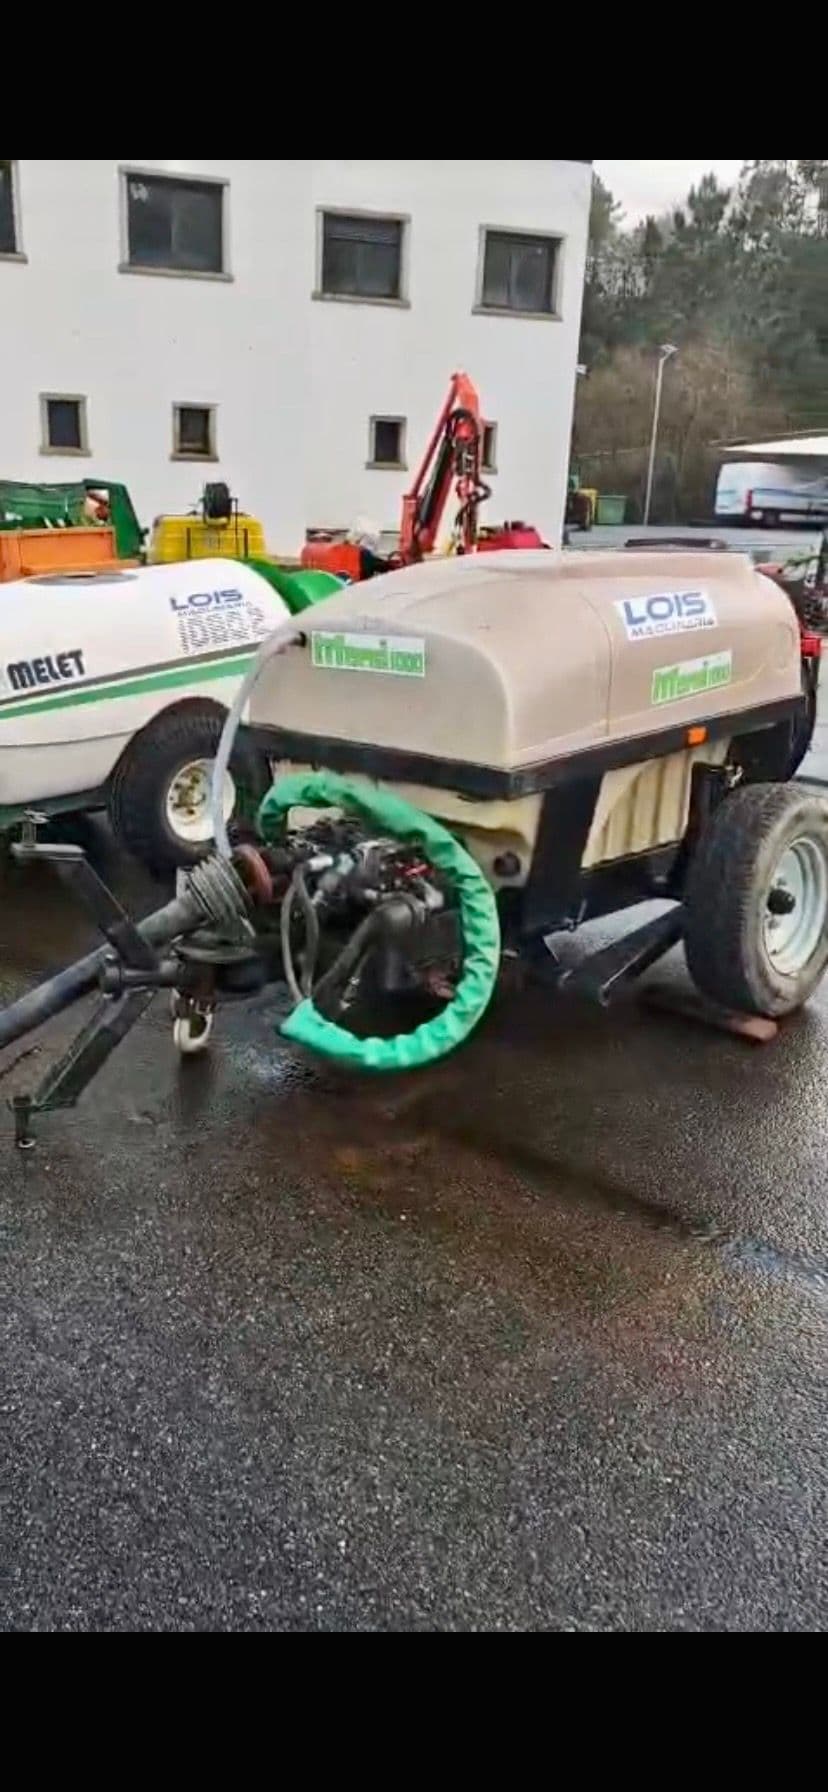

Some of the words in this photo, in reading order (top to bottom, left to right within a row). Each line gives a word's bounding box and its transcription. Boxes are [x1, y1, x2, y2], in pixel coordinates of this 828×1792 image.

[169, 589, 243, 611] LOIS
[623, 592, 706, 625] LOIS
[7, 648, 85, 690] MELET
